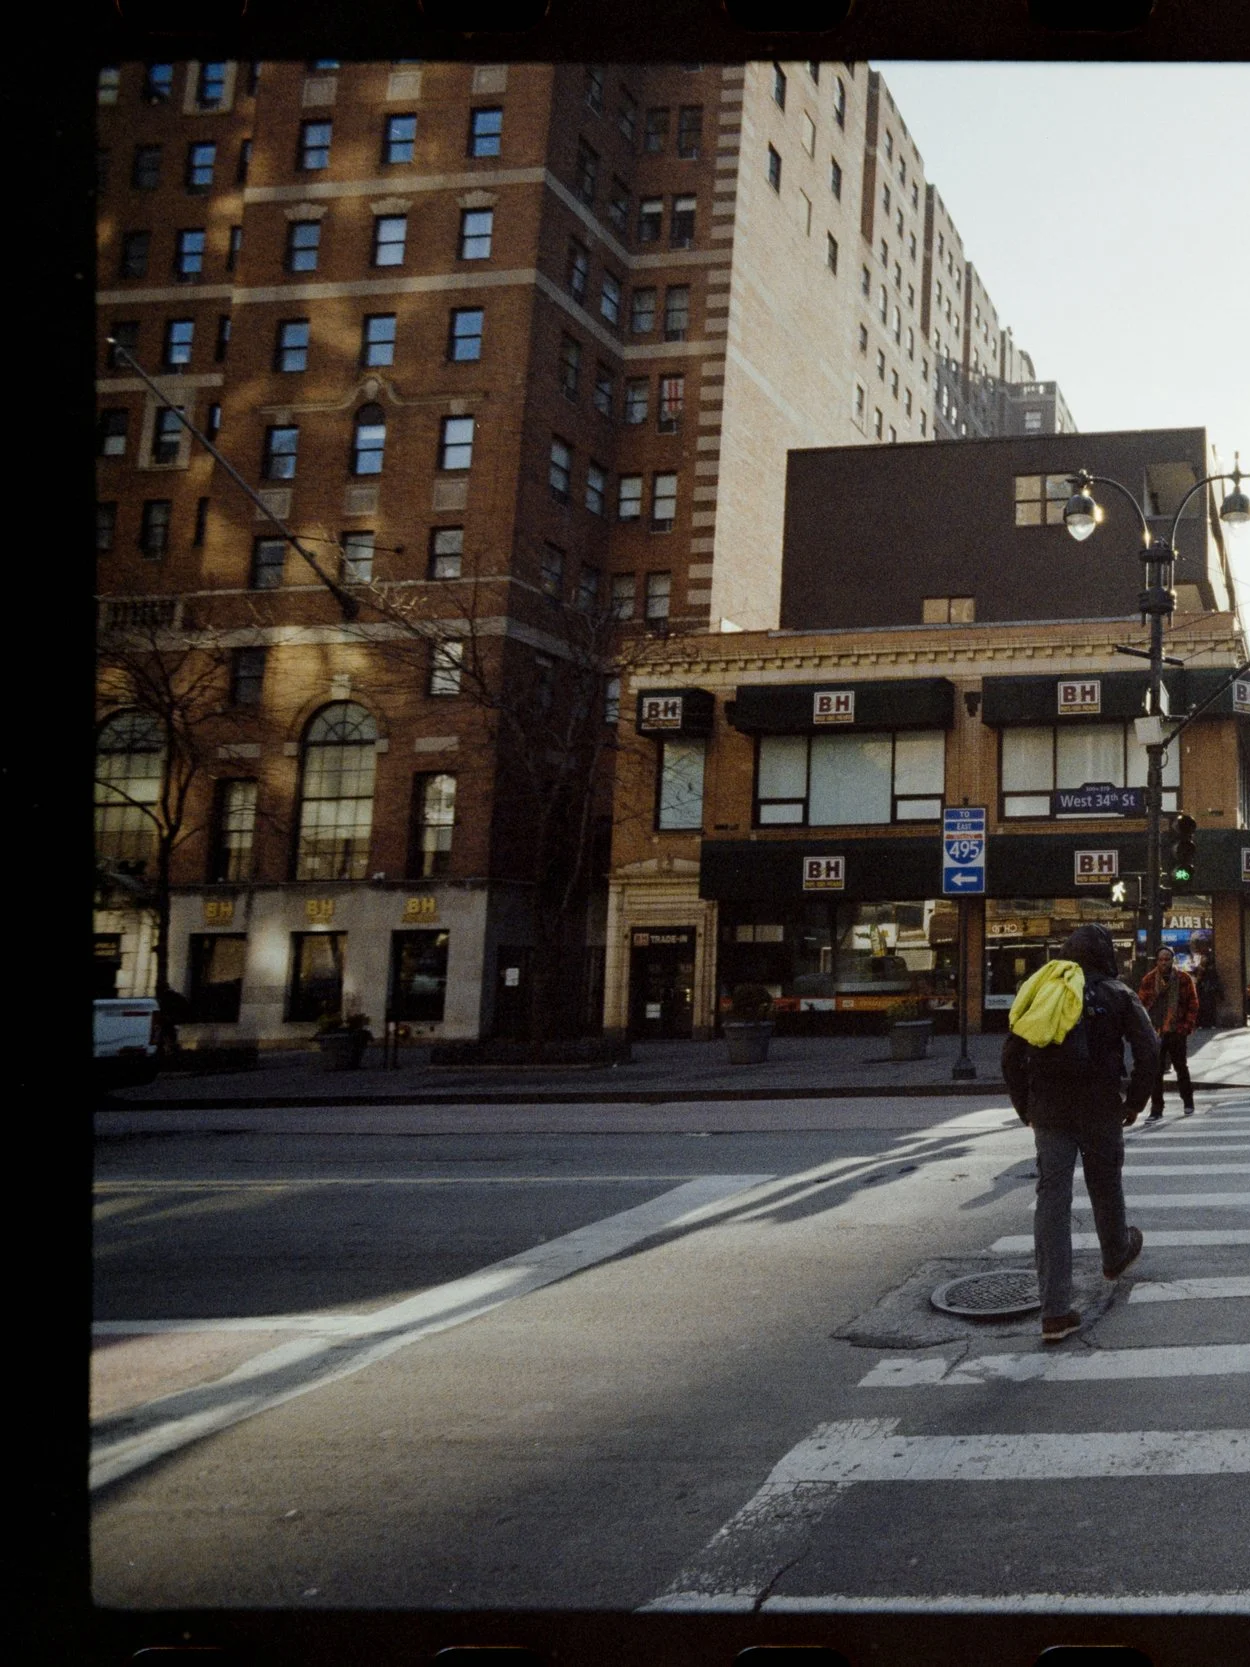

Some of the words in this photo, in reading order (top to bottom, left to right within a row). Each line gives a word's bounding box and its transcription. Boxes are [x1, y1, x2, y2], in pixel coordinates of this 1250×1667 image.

[1060, 794, 1093, 808] West
[1095, 794, 1119, 807] 34th
[1121, 793, 1136, 807] St
[956, 822, 972, 831] EAST
[948, 840, 980, 858] 495
[650, 934, 688, 944] TRADE-IN
